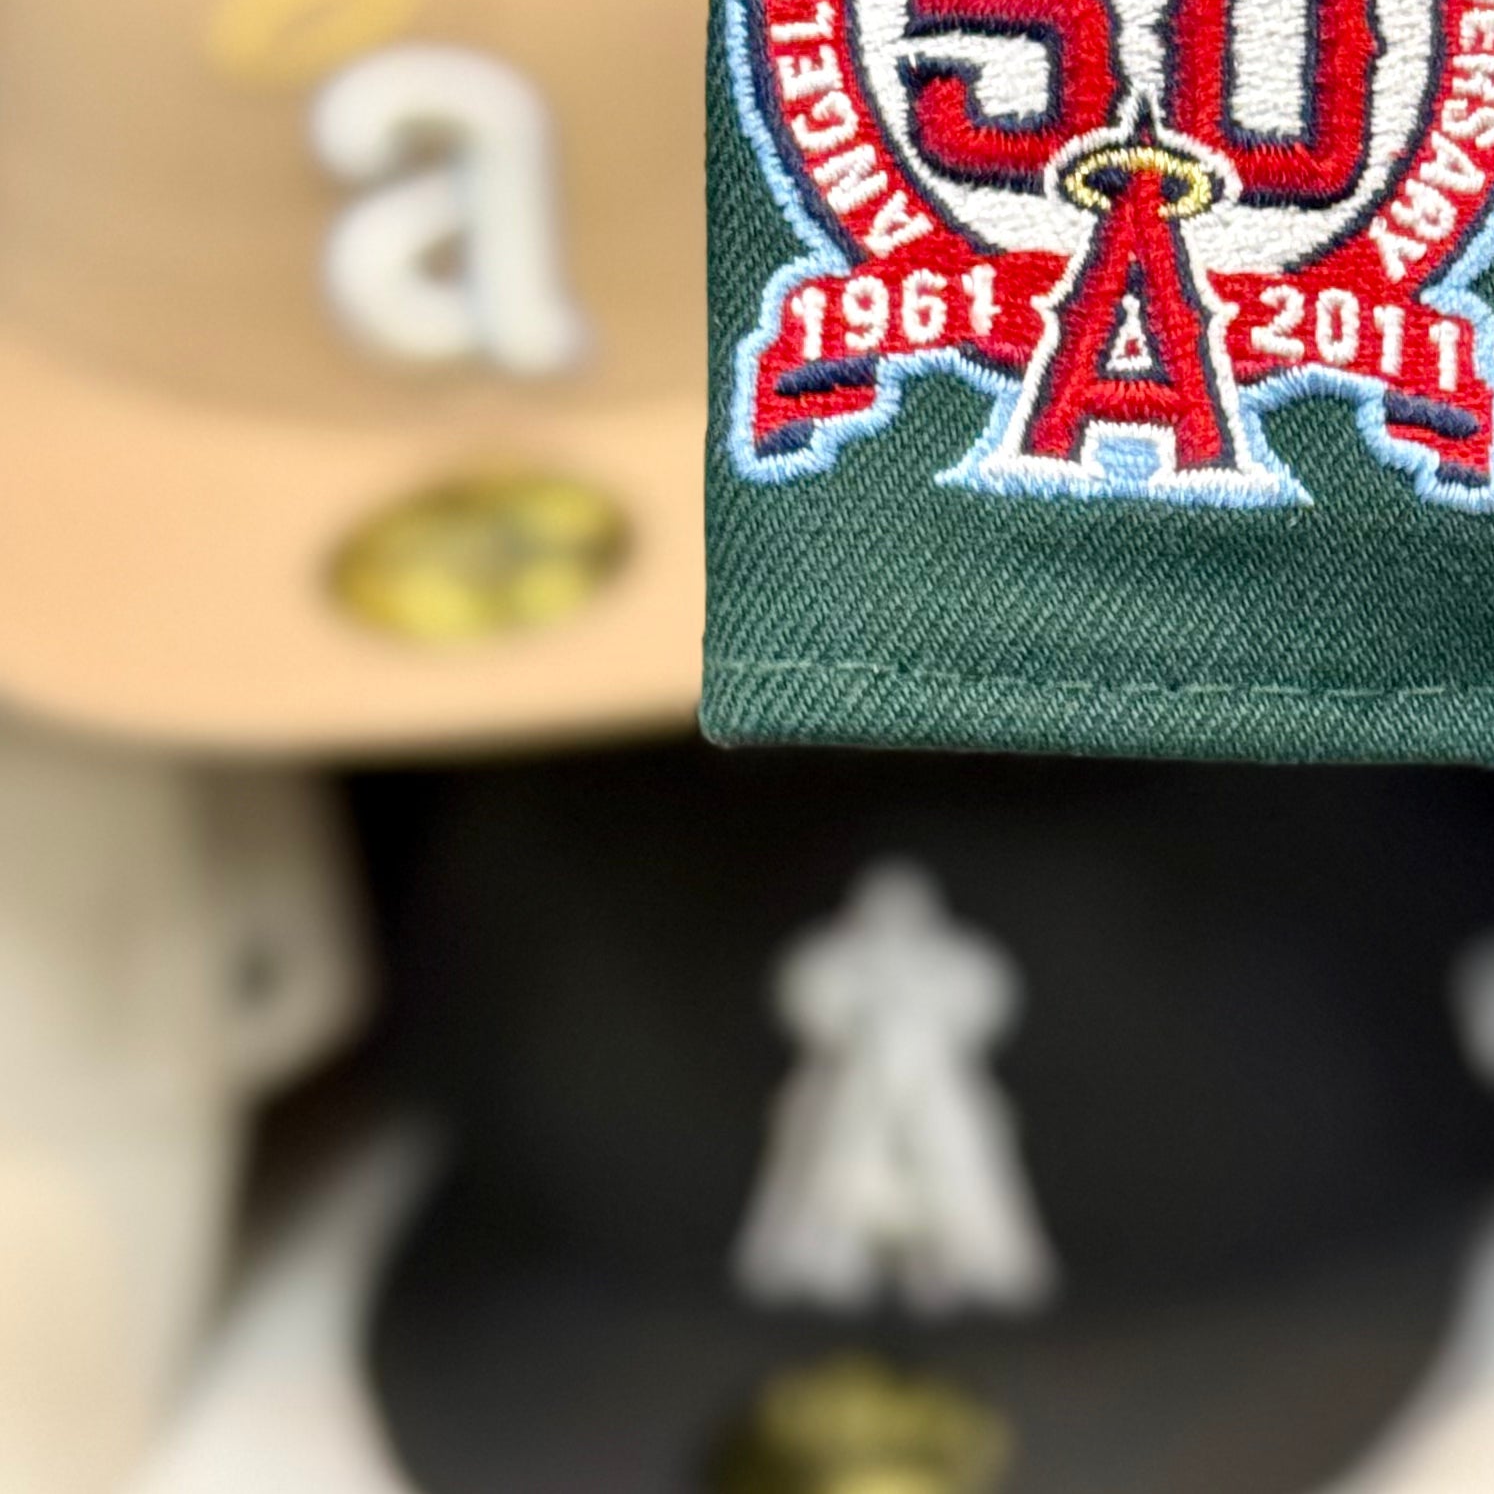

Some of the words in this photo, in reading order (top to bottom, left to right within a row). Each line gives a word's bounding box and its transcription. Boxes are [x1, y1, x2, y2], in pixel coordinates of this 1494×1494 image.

[310, 46, 582, 371] a
[791, 263, 1000, 360] 1961
[1010, 146, 1245, 471] A
[1250, 285, 1459, 391] 2011
